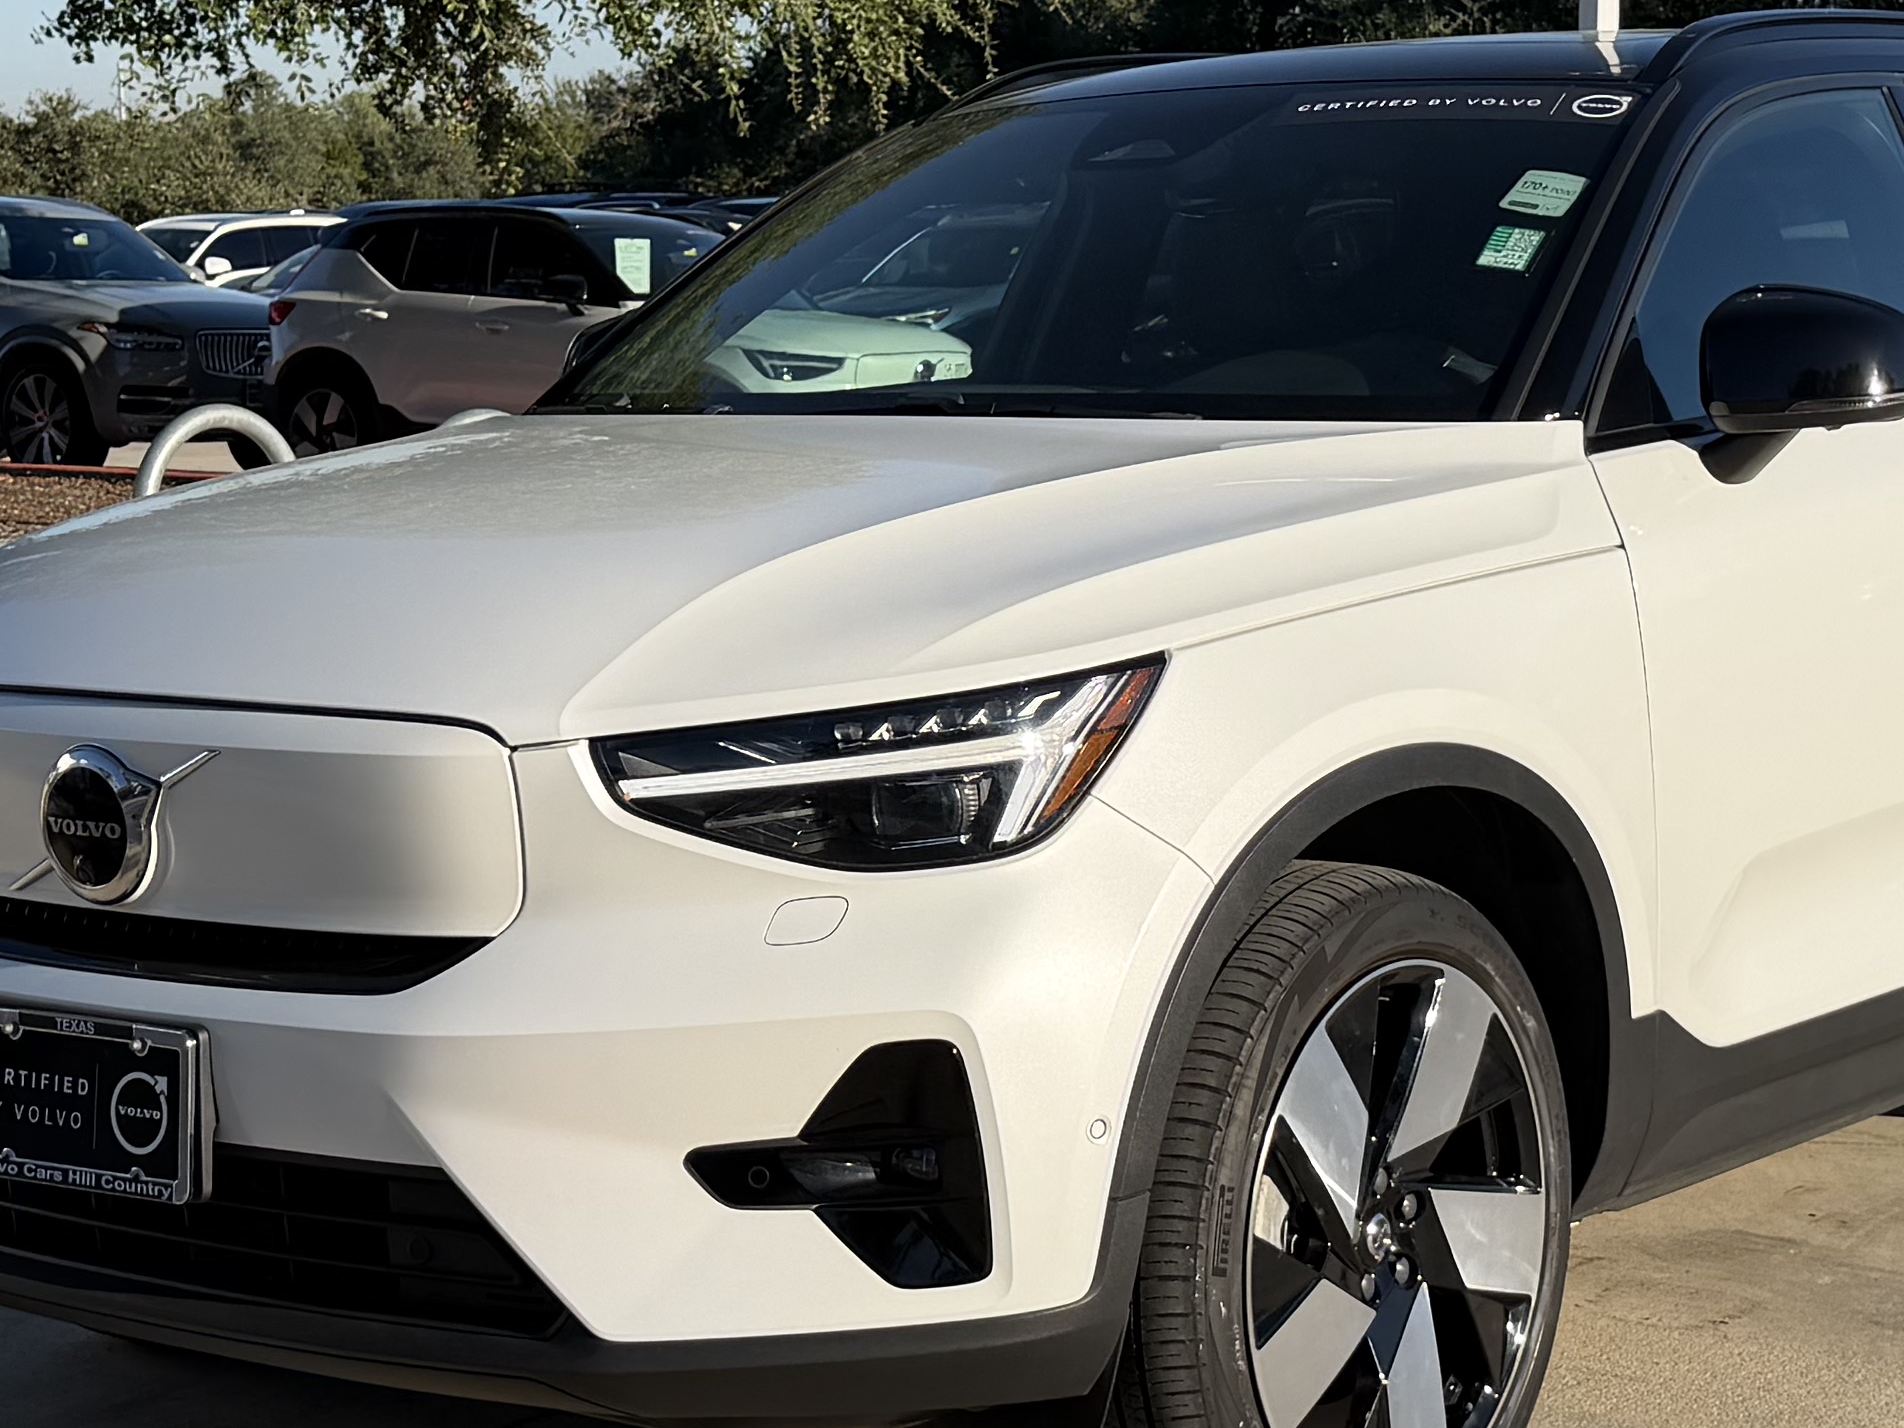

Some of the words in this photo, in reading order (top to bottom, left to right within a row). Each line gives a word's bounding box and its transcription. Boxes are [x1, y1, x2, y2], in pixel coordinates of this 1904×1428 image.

[1298, 99, 1417, 112] CERTIFIED
[1427, 98, 1457, 106] BY
[1467, 97, 1542, 106] VOLVO
[47, 816, 122, 839] VOLVO
[55, 1017, 95, 1035] TEXAS
[14, 1103, 82, 1129] VOLVO
[118, 1105, 161, 1119] VOLVO
[23, 1164, 63, 1182] Cars
[68, 1169, 96, 1187] Hill
[101, 1175, 172, 1200] Country
[1211, 1183, 1235, 1278] PIRELLI
